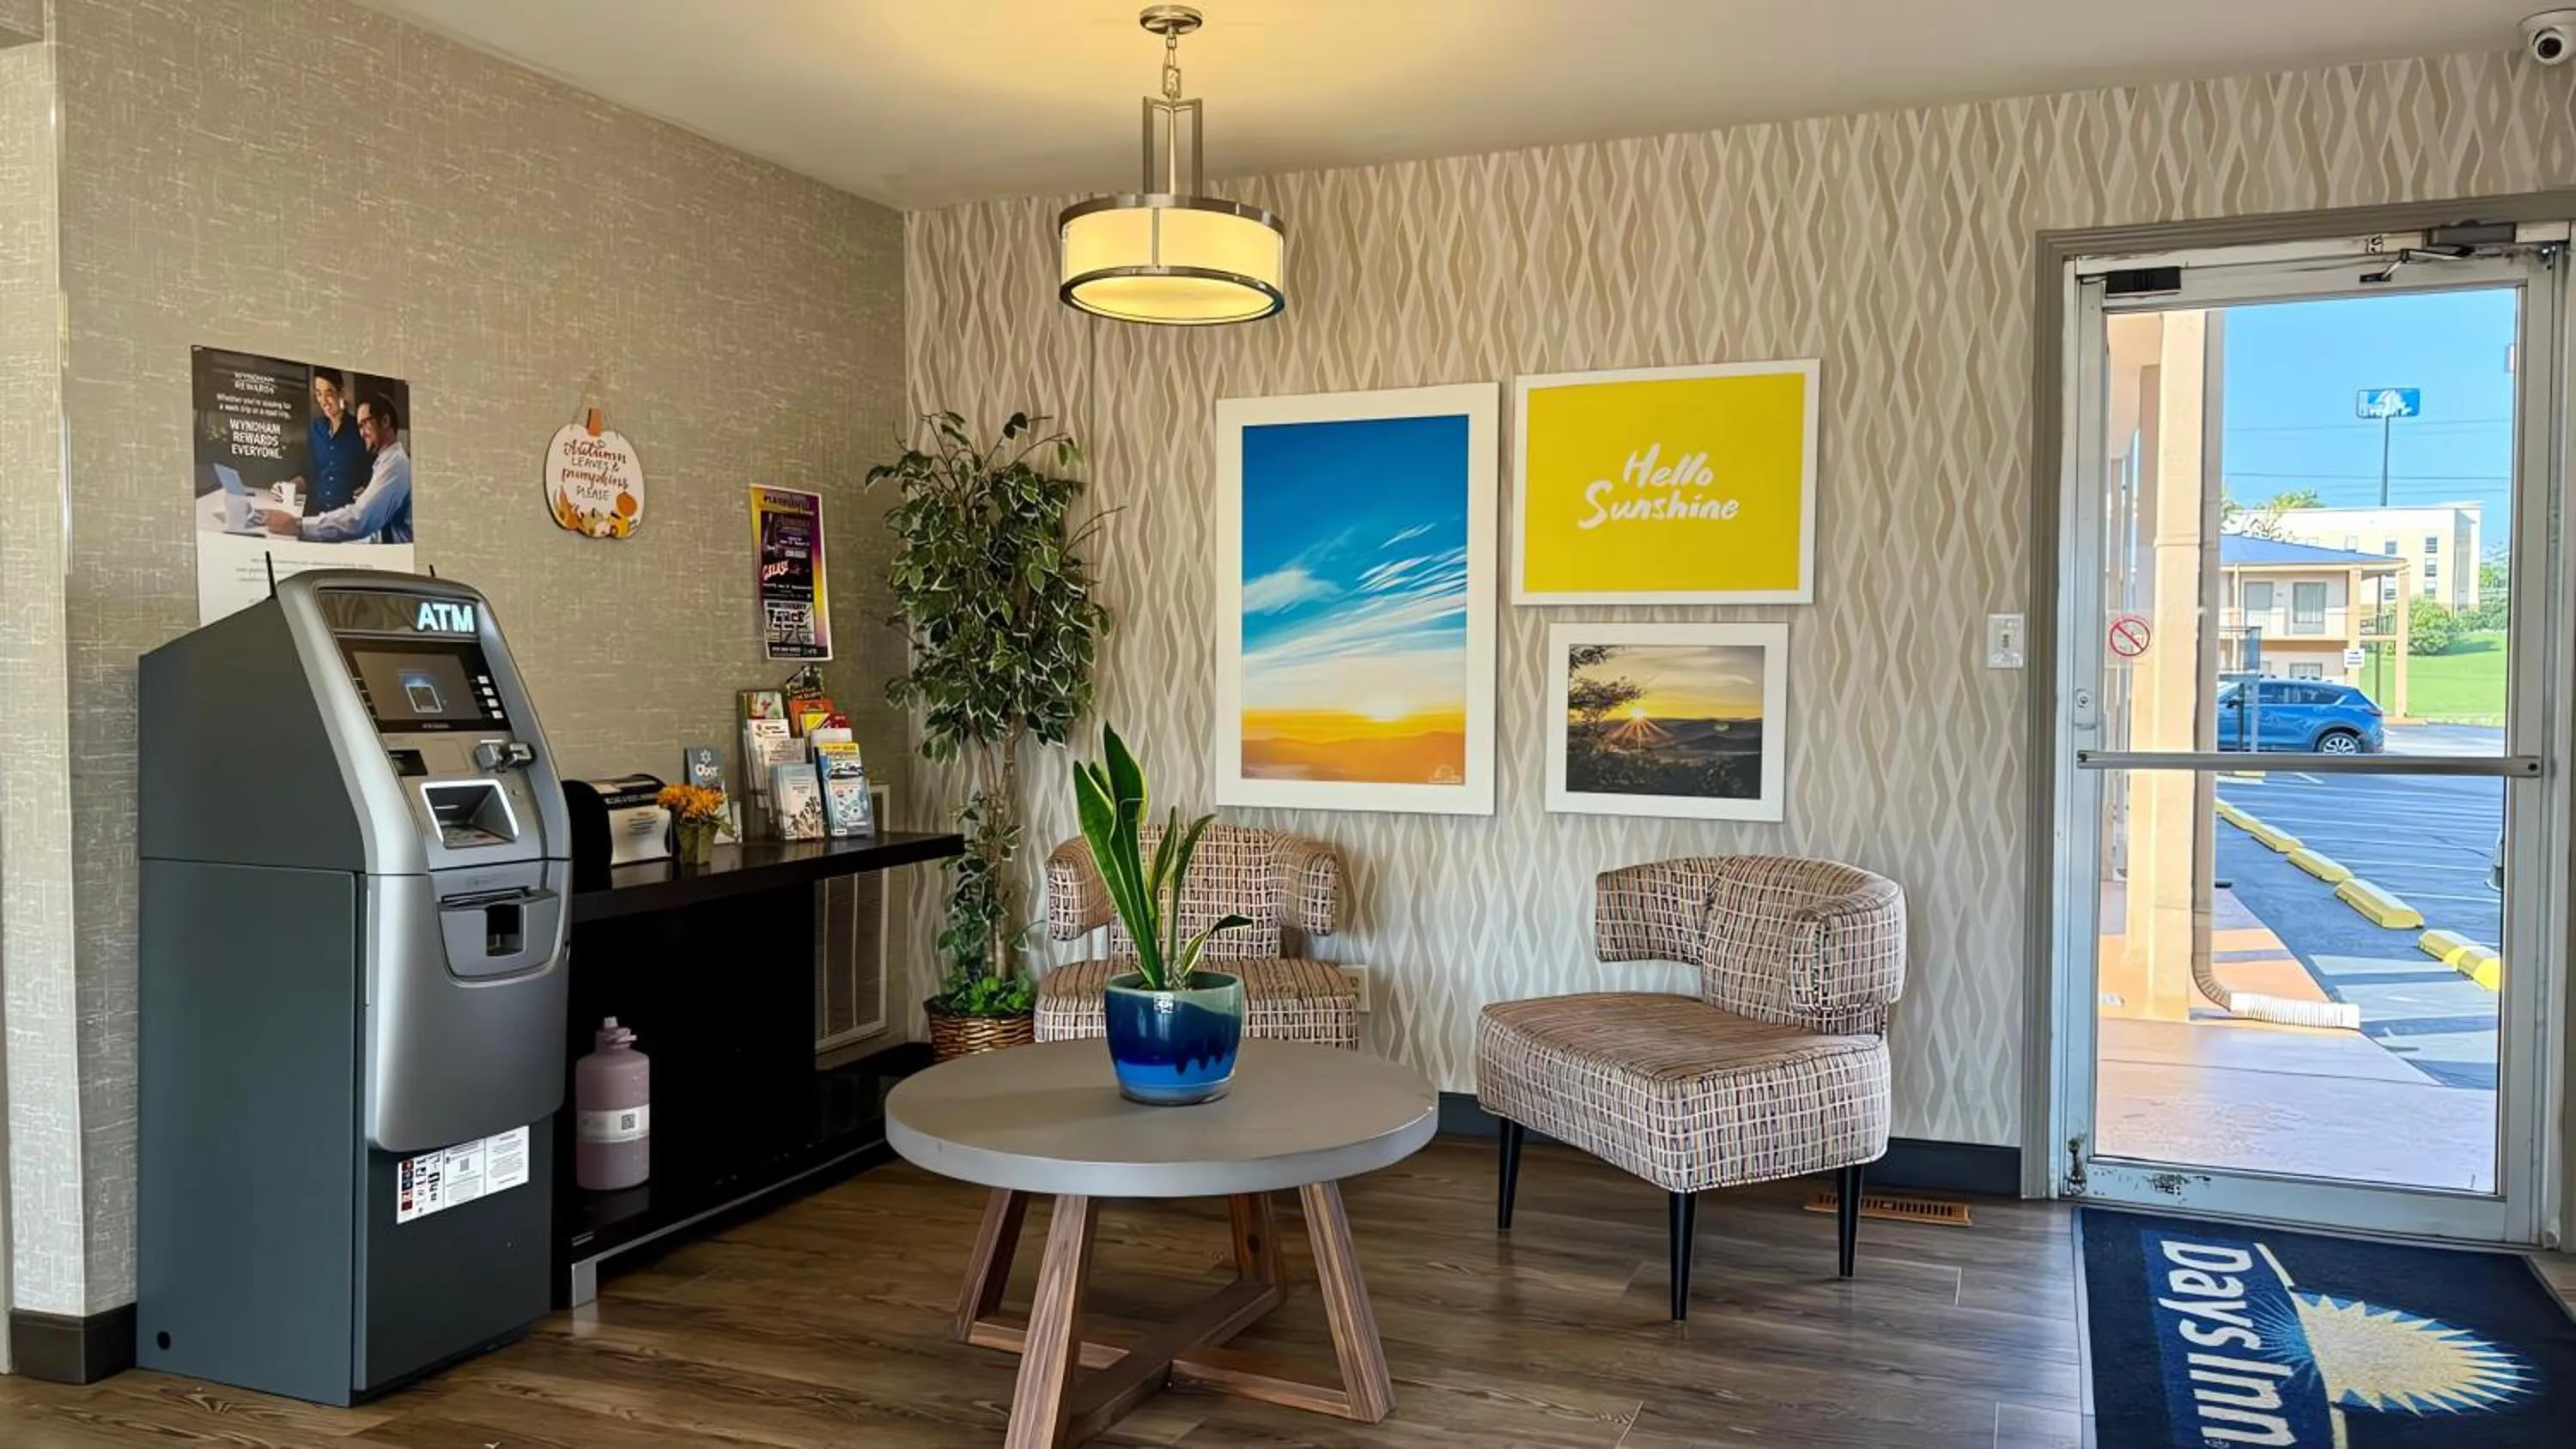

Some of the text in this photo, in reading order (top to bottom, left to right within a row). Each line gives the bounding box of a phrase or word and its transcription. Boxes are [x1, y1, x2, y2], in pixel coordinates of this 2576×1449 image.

[230, 418, 281, 435] WYNDHAM
[233, 431, 279, 447] REWARDS
[563, 439, 627, 464] Autumn
[572, 457, 609, 470] LEAVES
[1622, 441, 1715, 488] Hello
[576, 485, 611, 500] PLEASE
[1578, 479, 1741, 530] Sunshine
[416, 602, 475, 633] ATM
[2158, 1240, 2298, 1446] Days Inn
